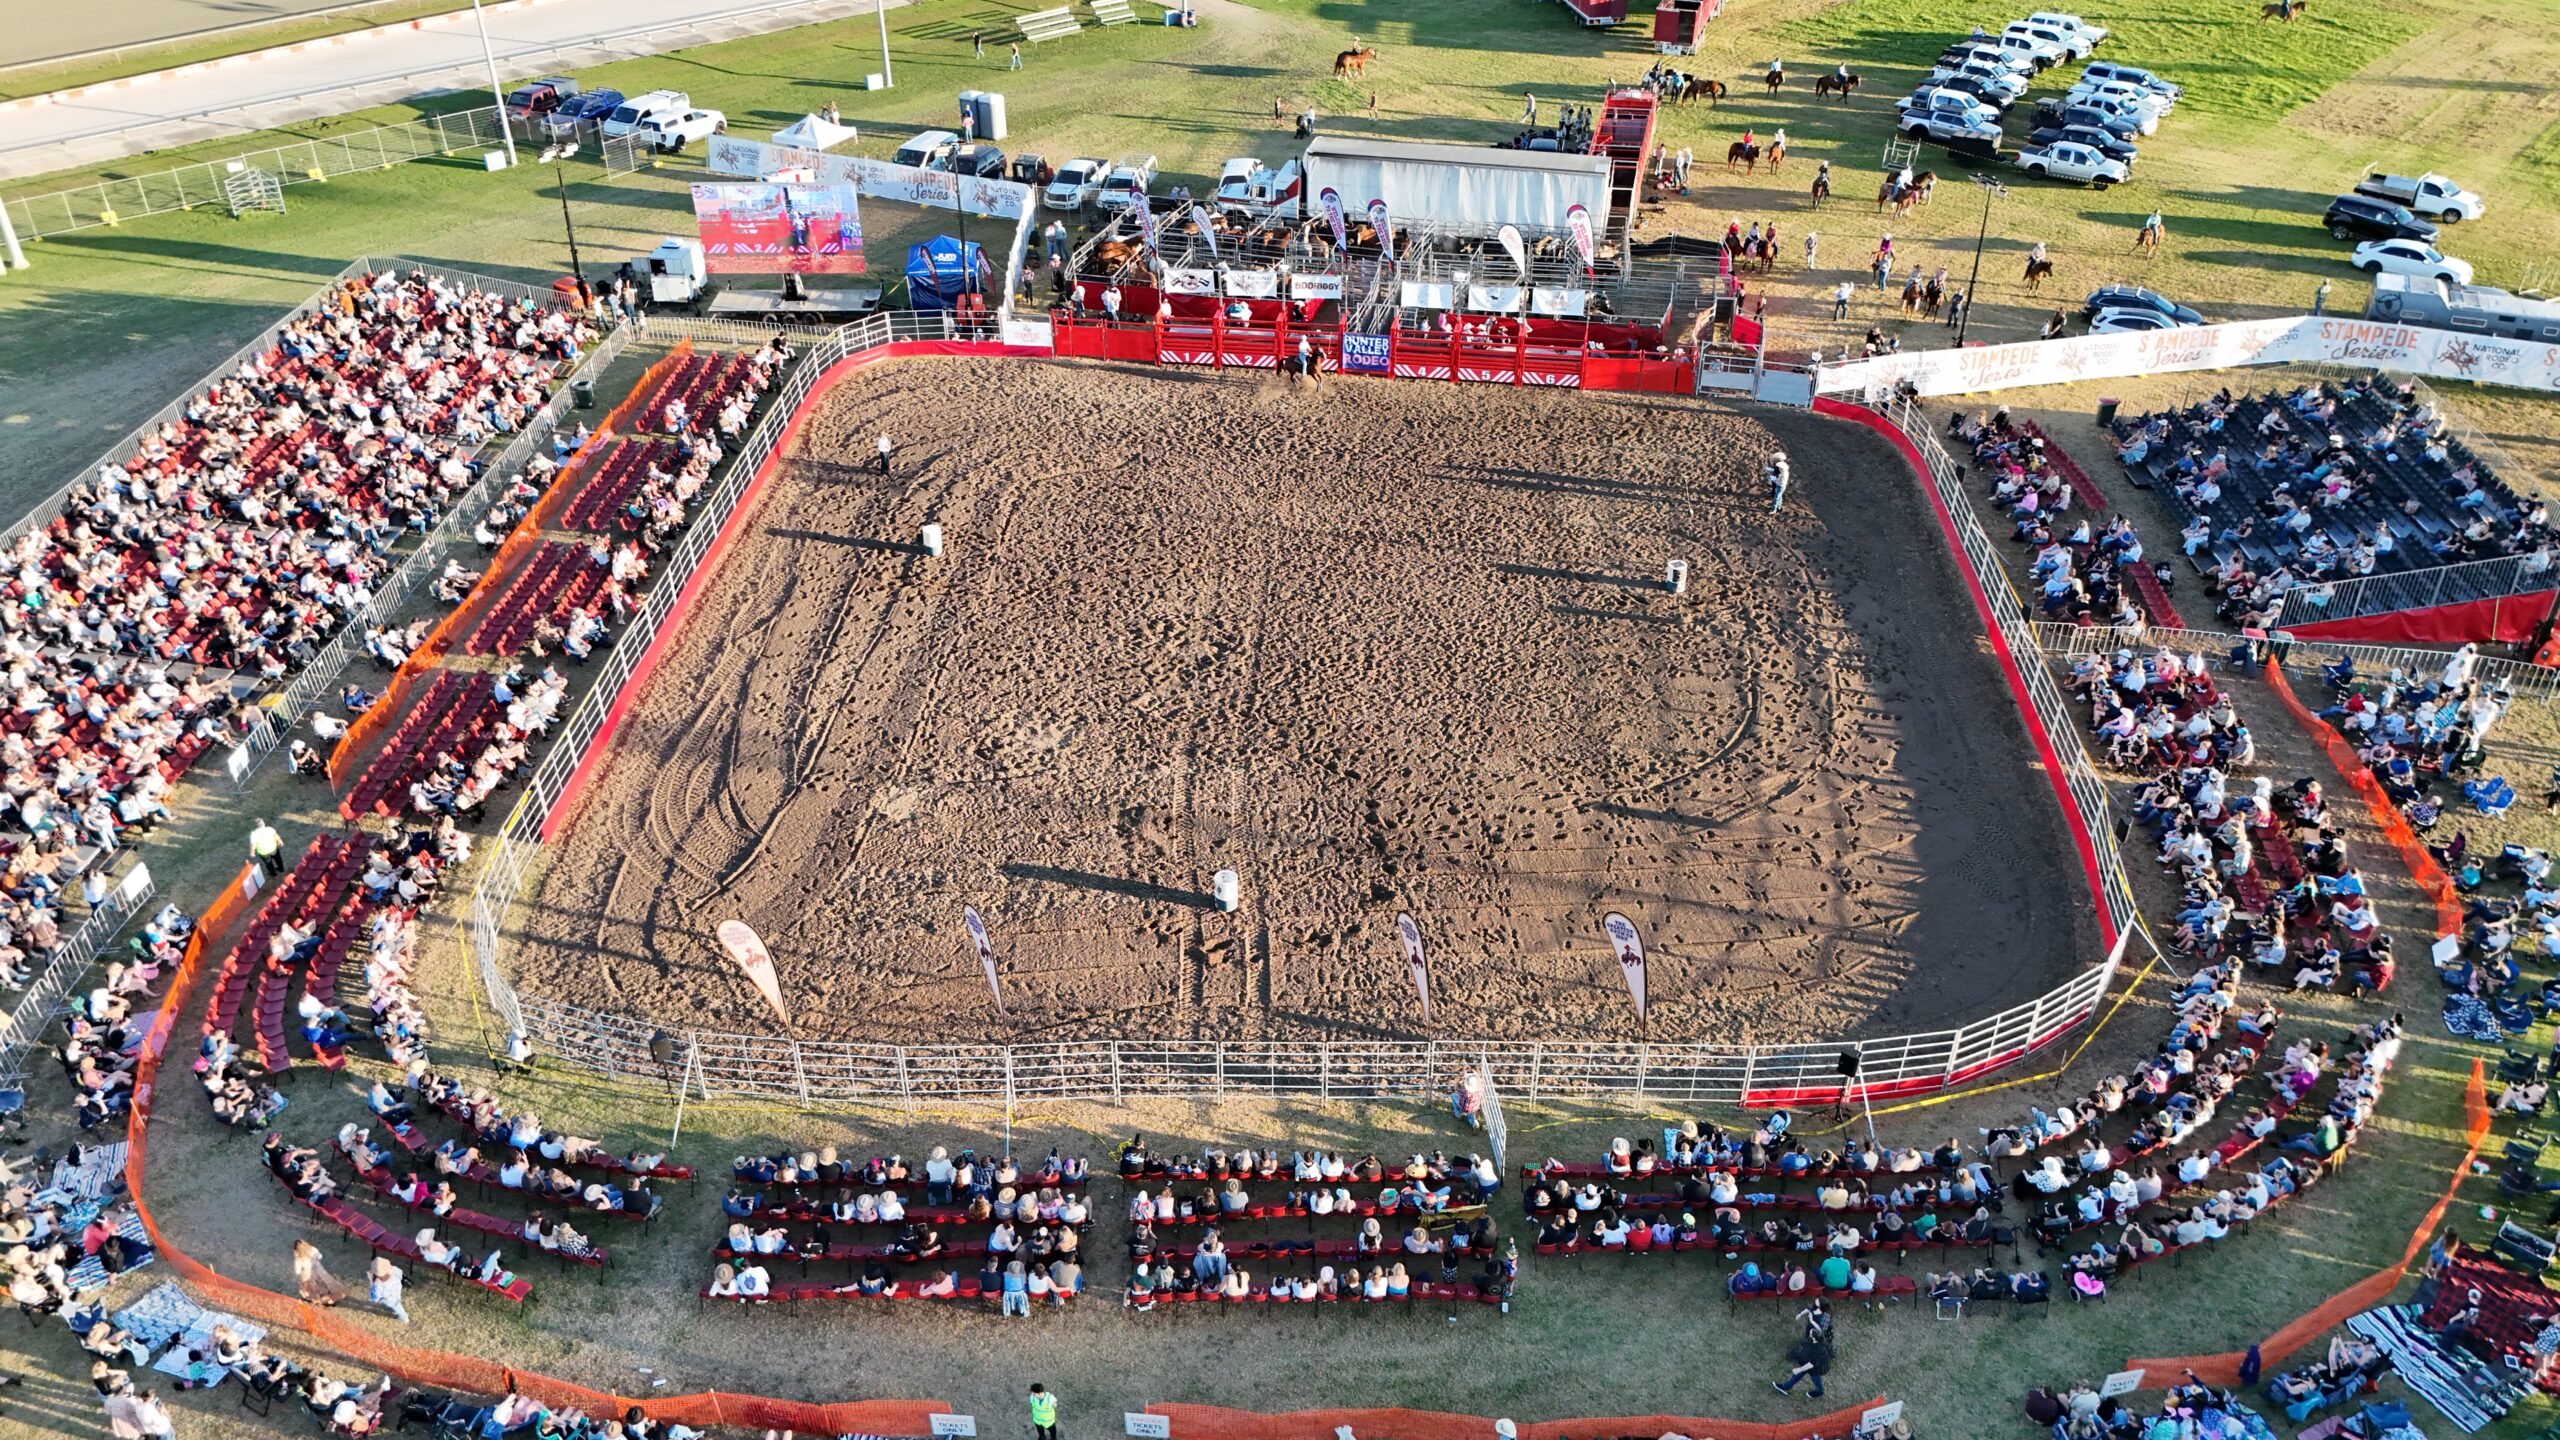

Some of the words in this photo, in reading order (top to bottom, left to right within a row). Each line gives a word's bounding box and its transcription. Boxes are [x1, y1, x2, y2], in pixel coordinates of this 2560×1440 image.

[896, 167, 958, 192] STAMPEDE
[909, 183, 950, 201] Series
[1294, 282, 1339, 290] BODRIGGY
[2138, 329, 2222, 352] SAMPEDE
[2320, 321, 2422, 349] STAMPEDE
[1344, 335, 1389, 348] HUNTER
[1345, 344, 1390, 355] VALLEY
[2330, 337, 2400, 360] Series
[2472, 343, 2521, 355] NATIONAL
[1184, 353, 1190, 362] 1
[1244, 355, 1253, 365] 2
[1343, 353, 1389, 366] RODEO
[2486, 353, 2520, 364] RODEO
[1417, 367, 1426, 377] 4
[1482, 370, 1490, 381] 5
[1546, 374, 1555, 384] 6
[1132, 1422, 1163, 1430] TICKETS
